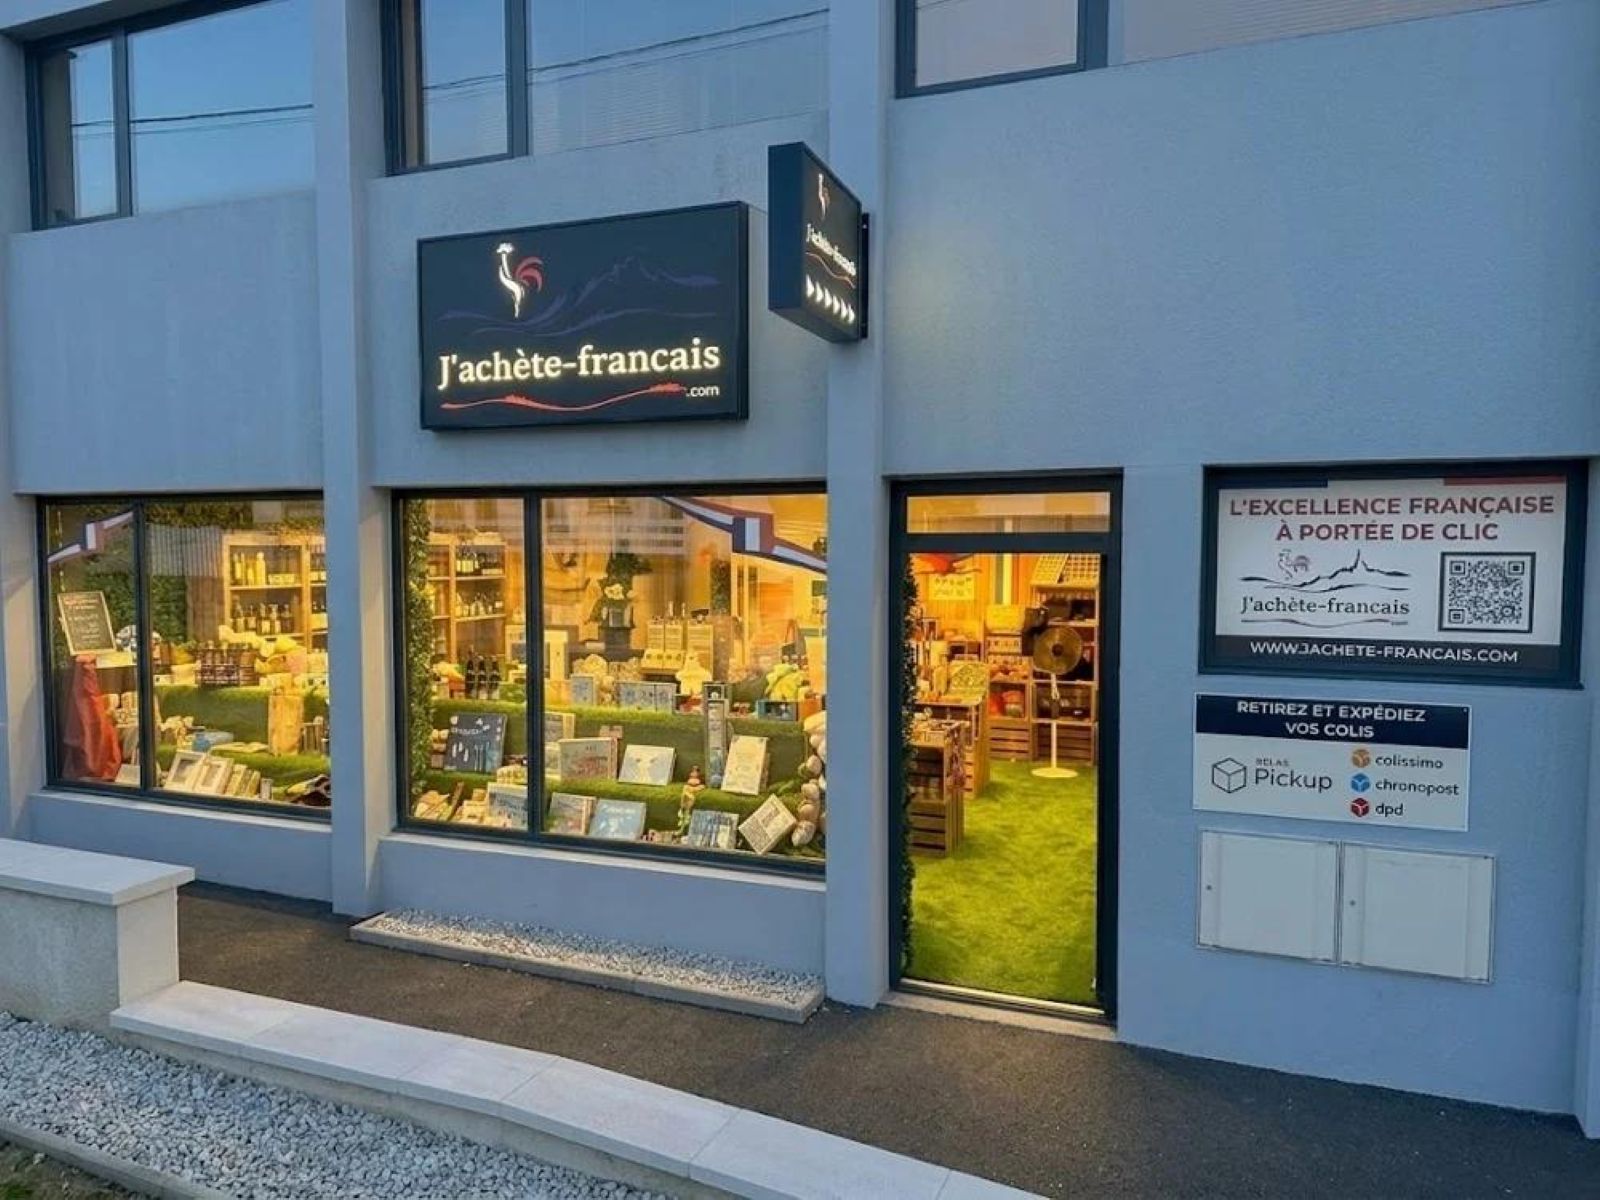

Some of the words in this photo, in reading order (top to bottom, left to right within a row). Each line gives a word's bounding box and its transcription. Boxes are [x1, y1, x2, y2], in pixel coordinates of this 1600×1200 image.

[437, 337, 721, 390] J'achète-francais
[685, 385, 720, 398] .com
[1230, 498, 1401, 516] L'EXCELLENCE
[1408, 496, 1555, 518] FRANÇAISE
[1275, 520, 1293, 541] À
[1299, 520, 1394, 541] PORTÉE
[1401, 524, 1434, 540] DE
[1441, 523, 1499, 540] CLIC
[1240, 596, 1410, 615] J'achète-francais
[1236, 701, 1309, 716] RETIREZ
[1312, 704, 1335, 718] ET
[1338, 704, 1427, 722] EXPÉDIEZ
[1285, 722, 1320, 735] VOS
[1323, 723, 1375, 738] COLIS
[1375, 755, 1444, 769] colissimo
[1255, 768, 1333, 793] Pickup
[1375, 779, 1460, 797] chronopost
[1375, 803, 1404, 818] dpd
